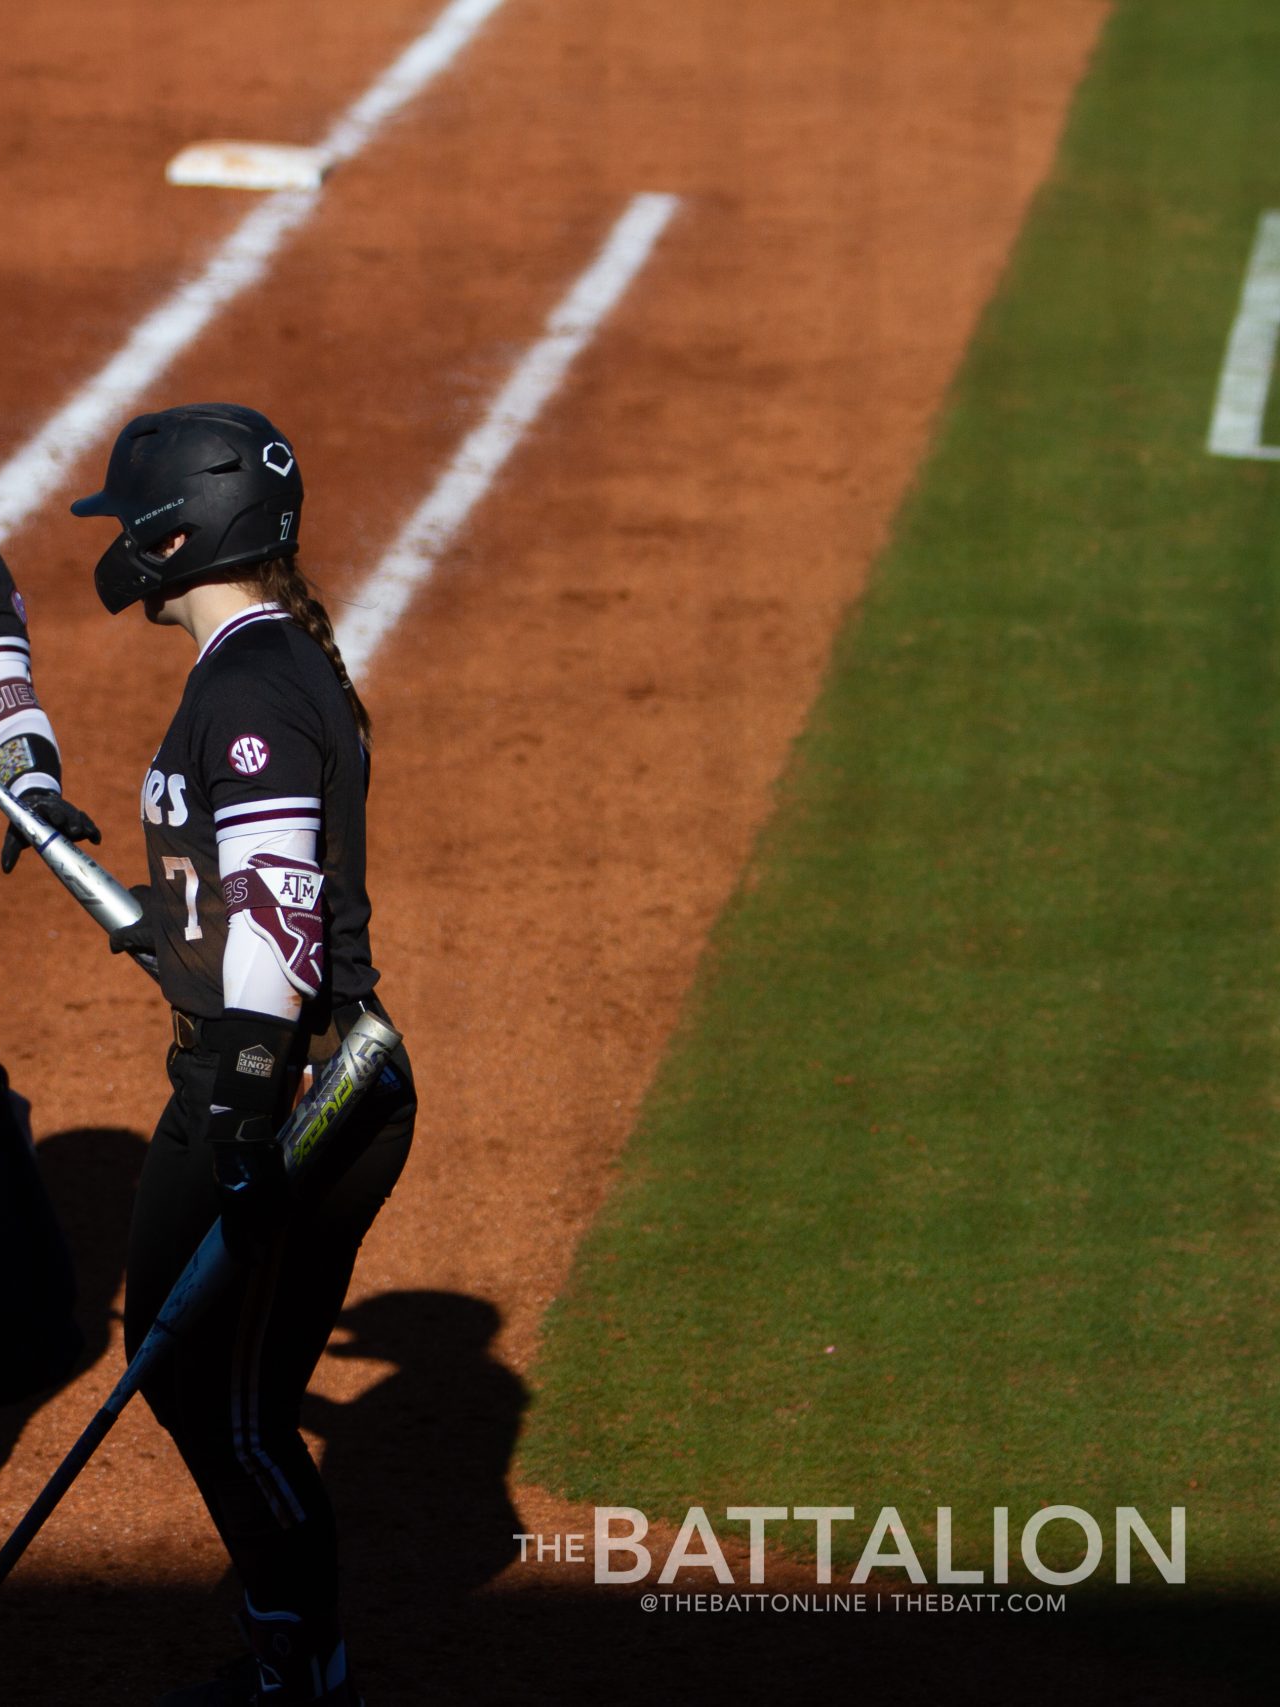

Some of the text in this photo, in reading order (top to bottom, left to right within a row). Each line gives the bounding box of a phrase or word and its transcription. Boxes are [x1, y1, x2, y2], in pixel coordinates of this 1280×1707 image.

[134, 498, 185, 525] EVOSHIELD
[280, 511, 293, 540] 7
[231, 737, 267, 773] SEC
[140, 746, 188, 827] es
[161, 856, 203, 940] 7
[239, 1058, 272, 1071] ZONE
[241, 1053, 273, 1064] SPORTS
